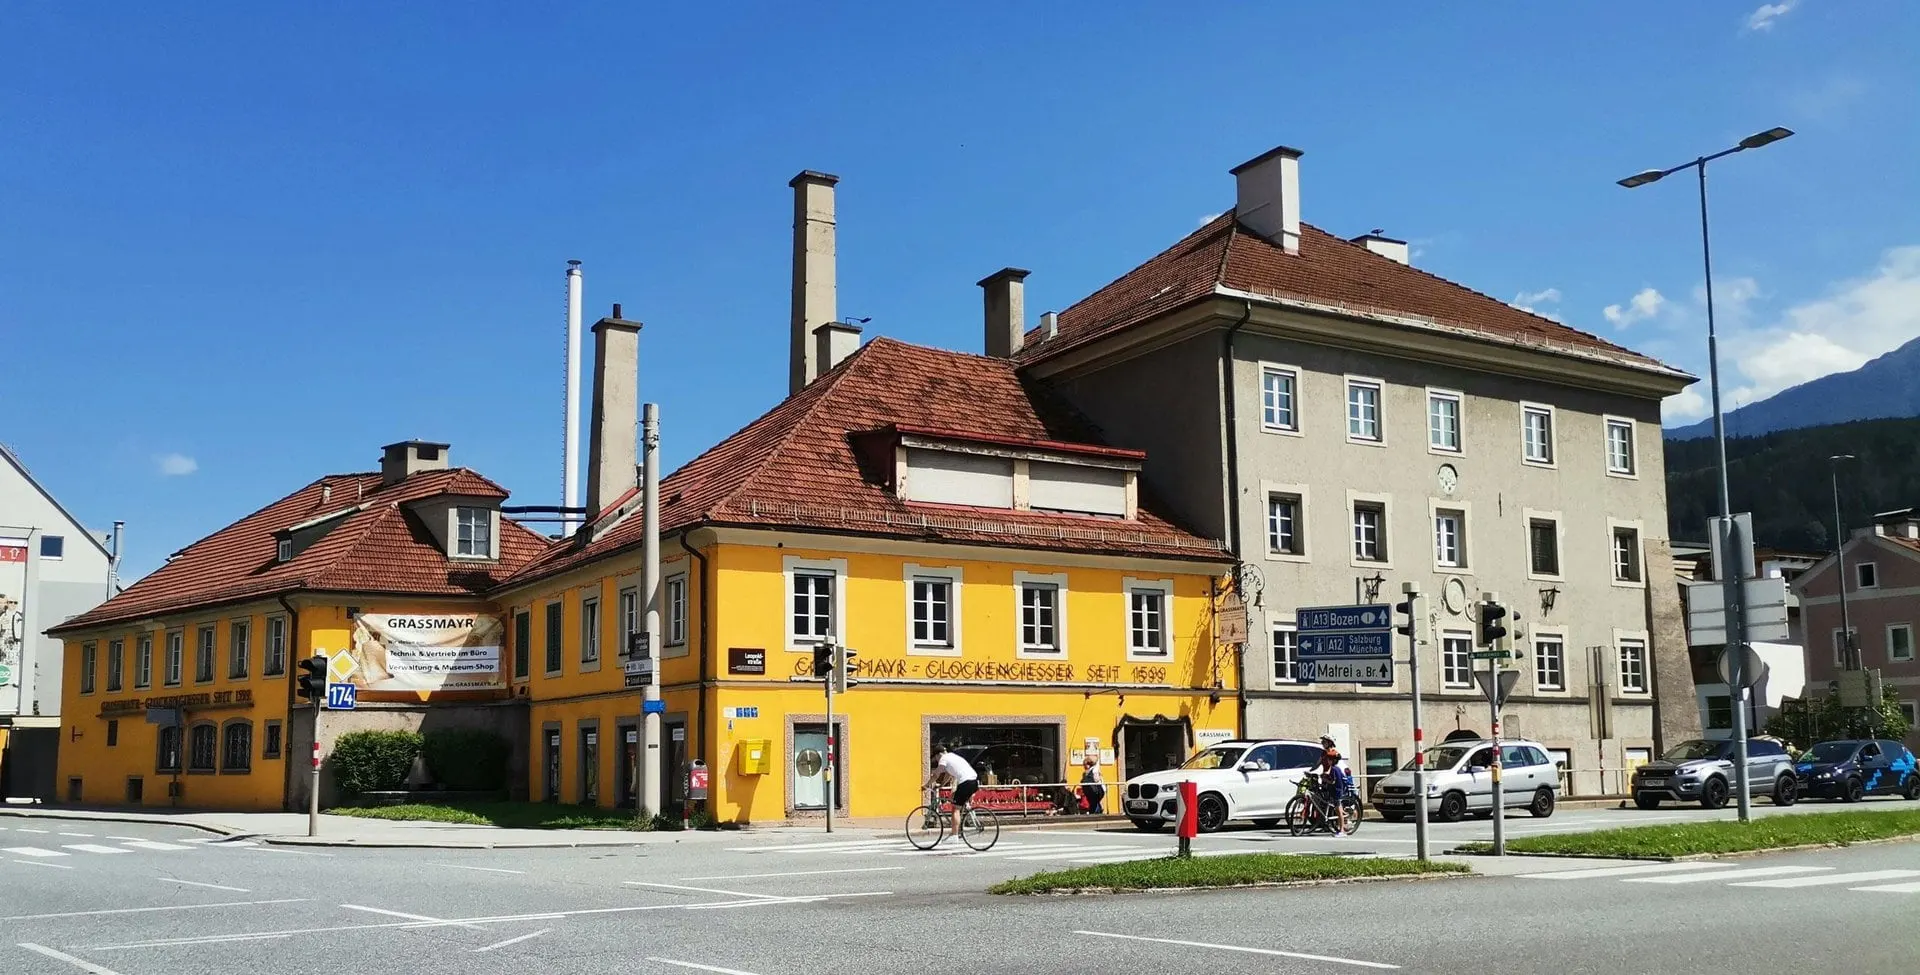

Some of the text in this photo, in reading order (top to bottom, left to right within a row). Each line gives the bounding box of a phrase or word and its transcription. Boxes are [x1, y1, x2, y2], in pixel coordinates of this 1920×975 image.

[387, 618, 474, 629] GRASSMAYR
[1313, 612, 1328, 626] A13
[1330, 612, 1359, 626] Bozen
[1328, 638, 1342, 651] A12
[1349, 635, 1381, 645] Salzburg
[1349, 644, 1382, 653] München
[388, 663, 432, 672] Verwaltung
[442, 662, 495, 671] Museum-Shop
[925, 660, 1074, 682] GLOCKENGIESSER
[1086, 664, 1121, 683] SEIT
[1131, 665, 1166, 684] 1599
[1298, 662, 1378, 679] 182 Matrei a. Br.
[330, 686, 352, 705] 174
